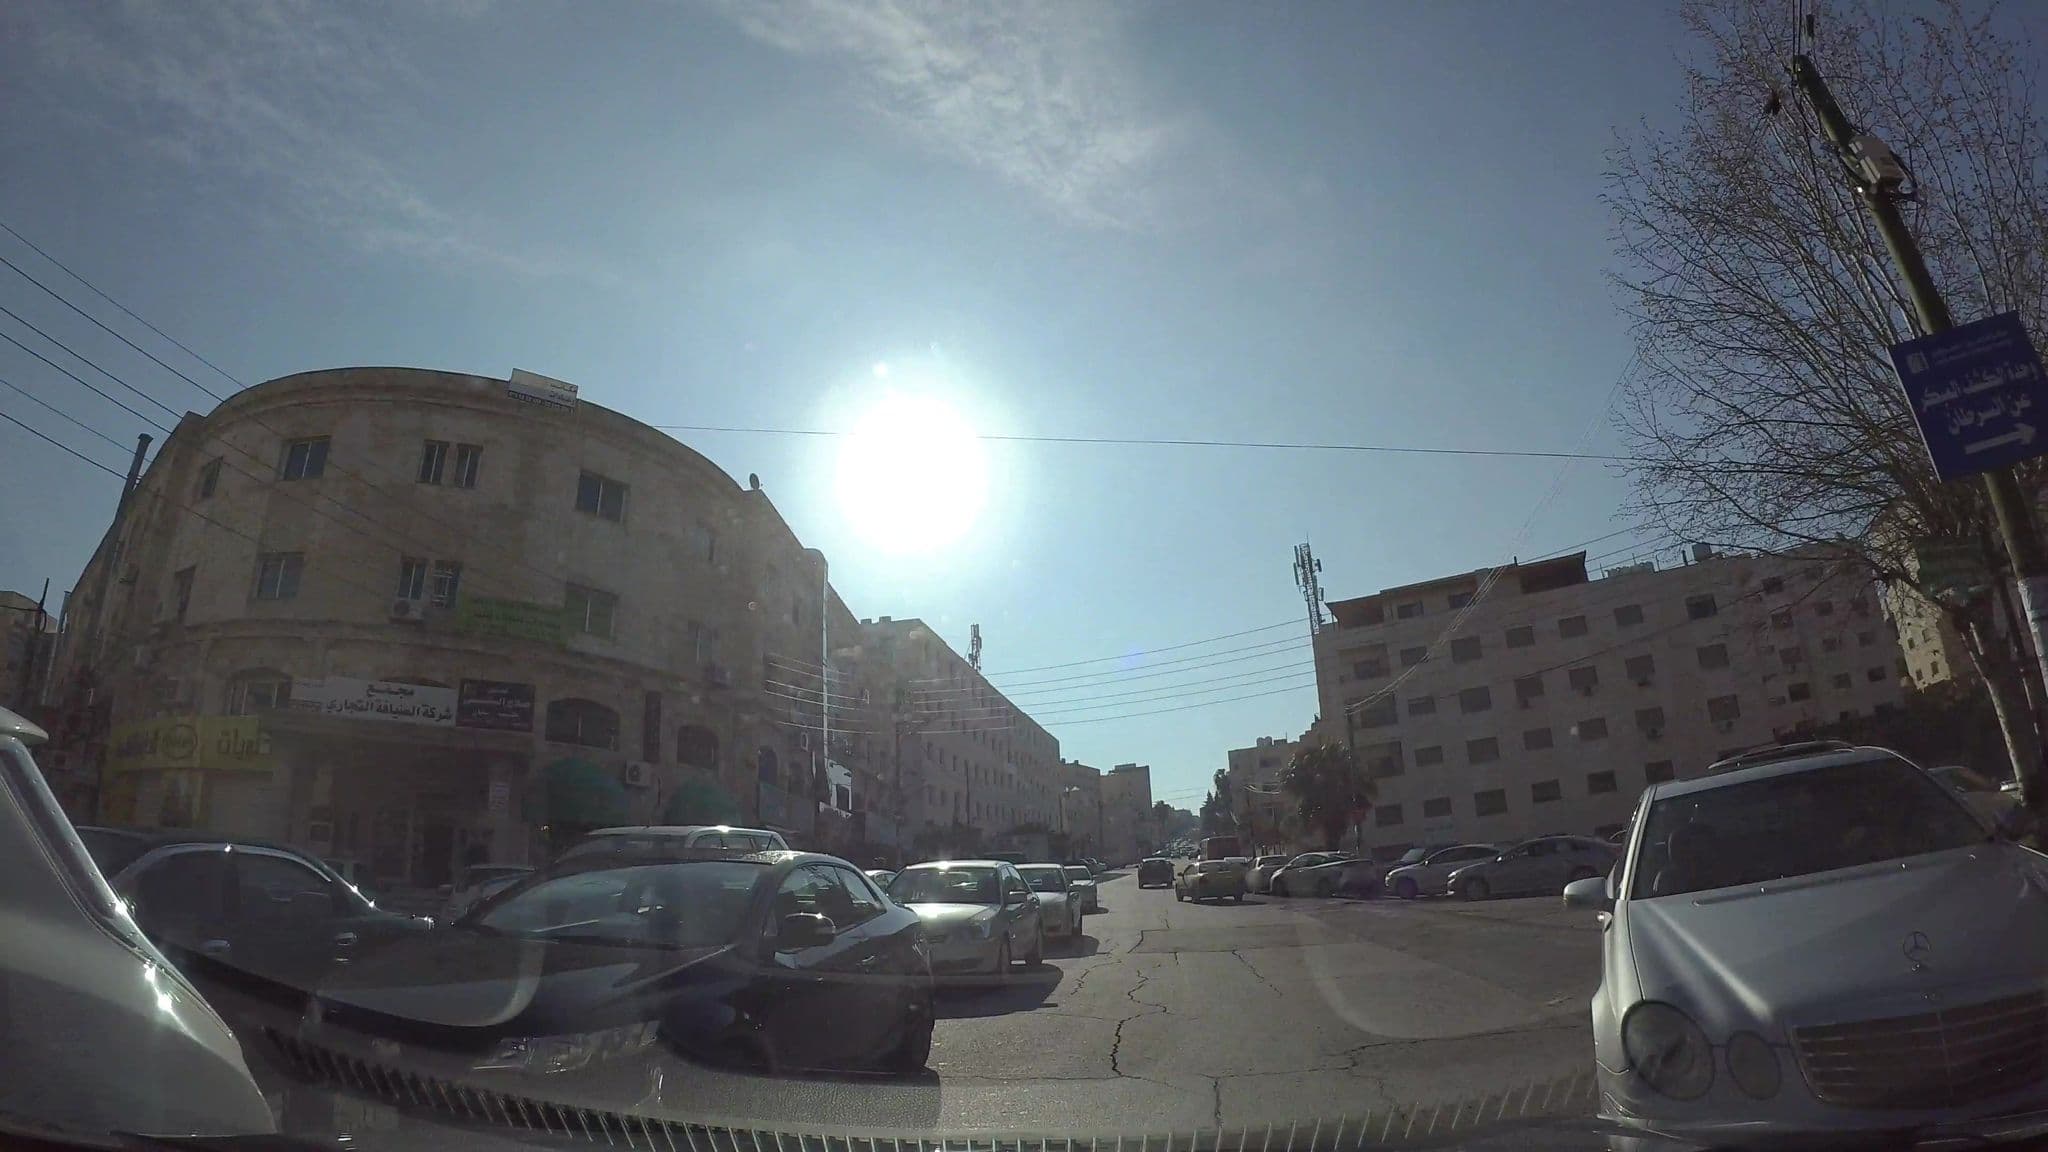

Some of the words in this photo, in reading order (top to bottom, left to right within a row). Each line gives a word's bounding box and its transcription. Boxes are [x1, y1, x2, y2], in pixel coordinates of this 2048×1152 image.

[1963, 366, 2004, 394] الكشف
[1921, 379, 1963, 412] المبكر
[2008, 393, 2032, 417] عن
[1945, 393, 2006, 435] السرطان
[422, 704, 452, 722] شركة
